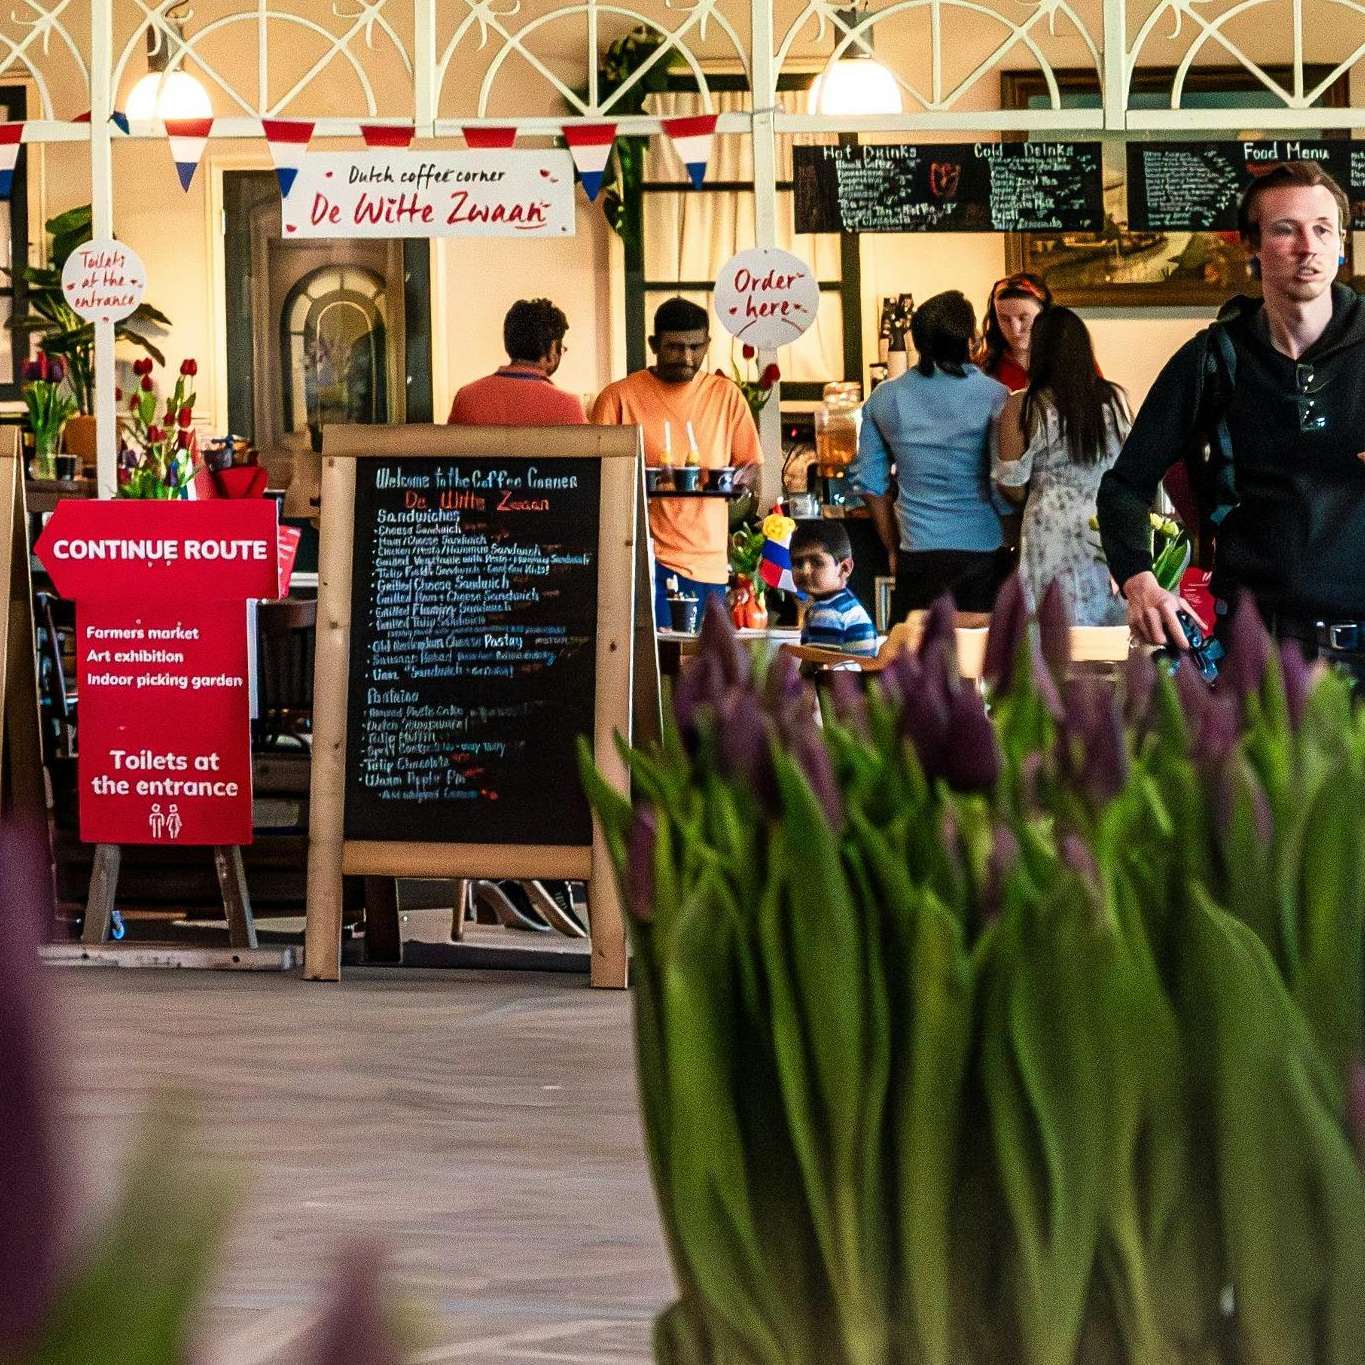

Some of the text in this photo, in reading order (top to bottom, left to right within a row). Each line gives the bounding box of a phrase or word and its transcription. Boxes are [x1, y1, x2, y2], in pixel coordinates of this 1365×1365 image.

[1244, 141, 1278, 160] Food
[350, 164, 505, 189] Dutch coffee corner
[311, 191, 547, 227] De Witte Zwaan
[82, 270, 124, 288] at the
[735, 268, 797, 293] Order
[75, 291, 134, 307] entrance
[746, 295, 789, 318] here
[376, 467, 430, 489] Welcome
[472, 470, 521, 488] Coffee
[405, 491, 426, 509] De
[497, 491, 549, 511] Zwaan
[377, 509, 460, 523] Sandwiches
[54, 540, 267, 561] CONTINUE ROUTE
[87, 624, 199, 639] Farmers market
[87, 649, 183, 663] Art exhibition
[87, 673, 243, 689] Indoor picking garden
[109, 750, 220, 771] Toilets at
[92, 776, 238, 797] the entrance
